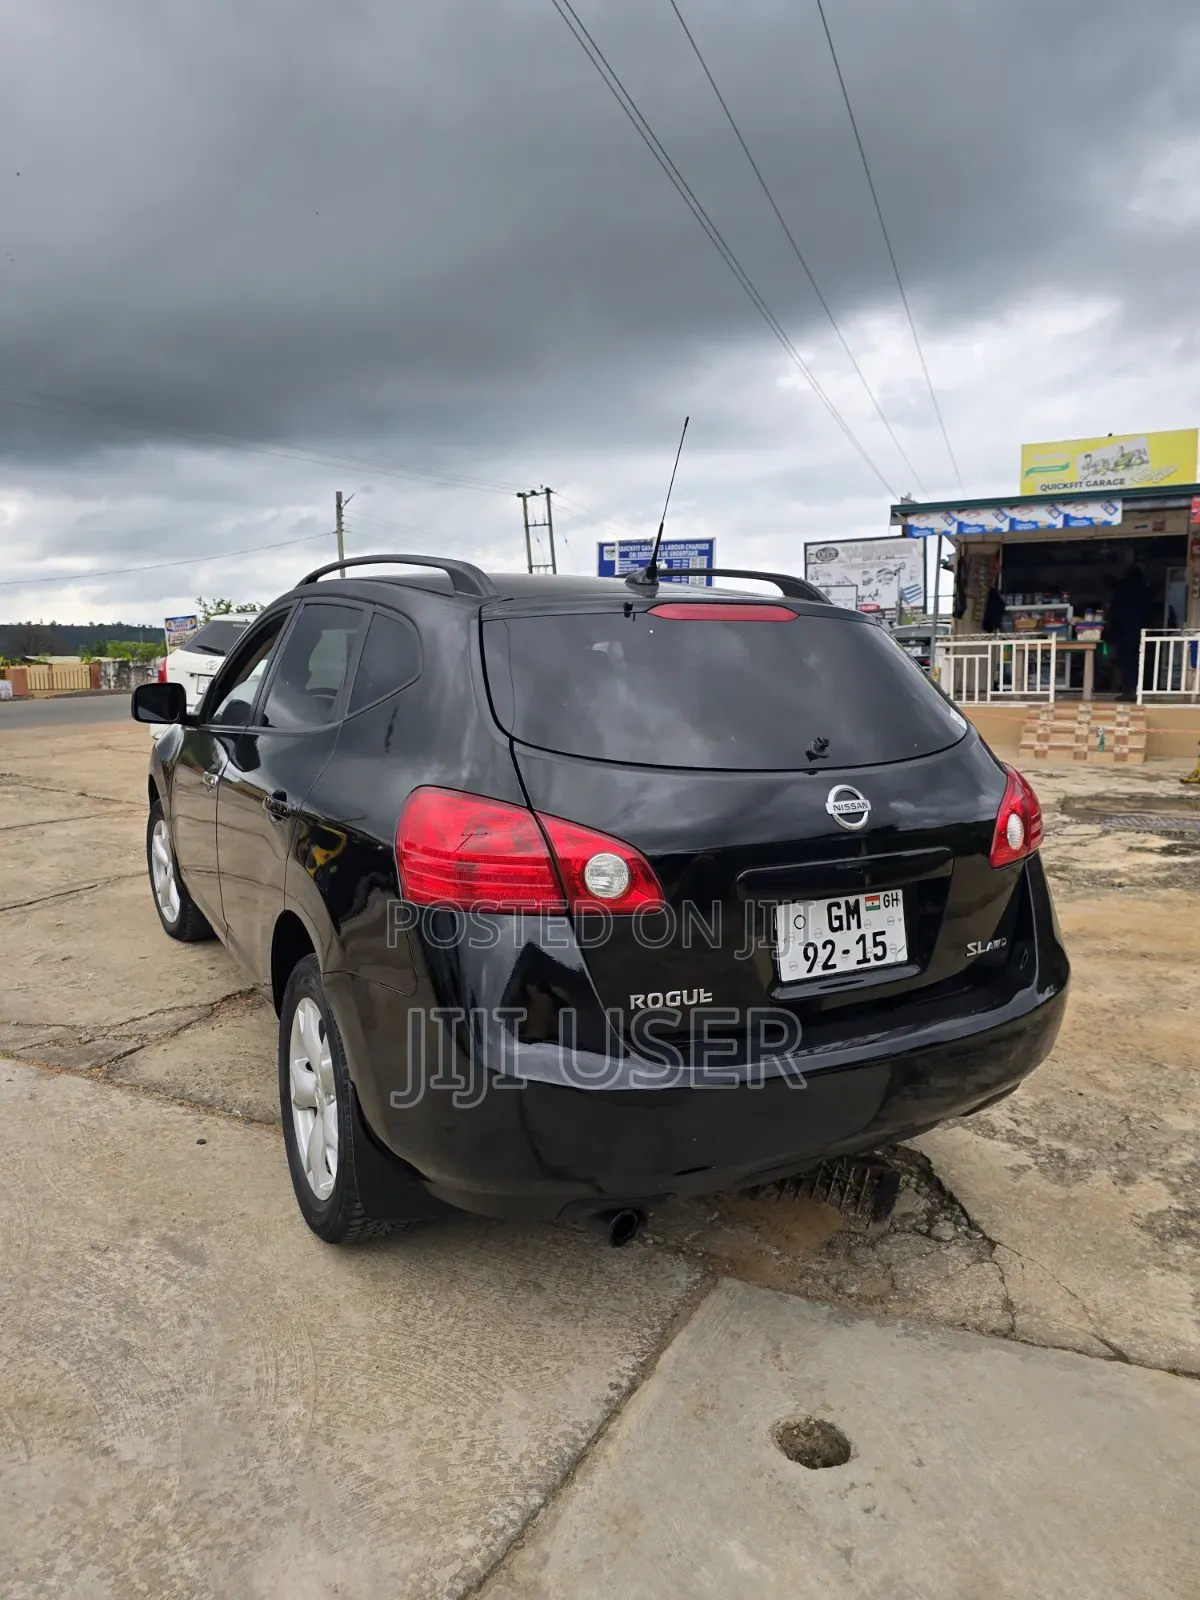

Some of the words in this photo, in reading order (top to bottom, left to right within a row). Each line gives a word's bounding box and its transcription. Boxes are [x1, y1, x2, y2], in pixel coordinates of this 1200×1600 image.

[1040, 481, 1084, 492] QUICKFIT
[1085, 477, 1126, 488] GARAGE
[832, 802, 868, 811] NISSAN
[883, 892, 900, 909] GH
[826, 898, 862, 933] GM
[803, 930, 887, 974] 92-15
[629, 988, 713, 1010] ROGUE
